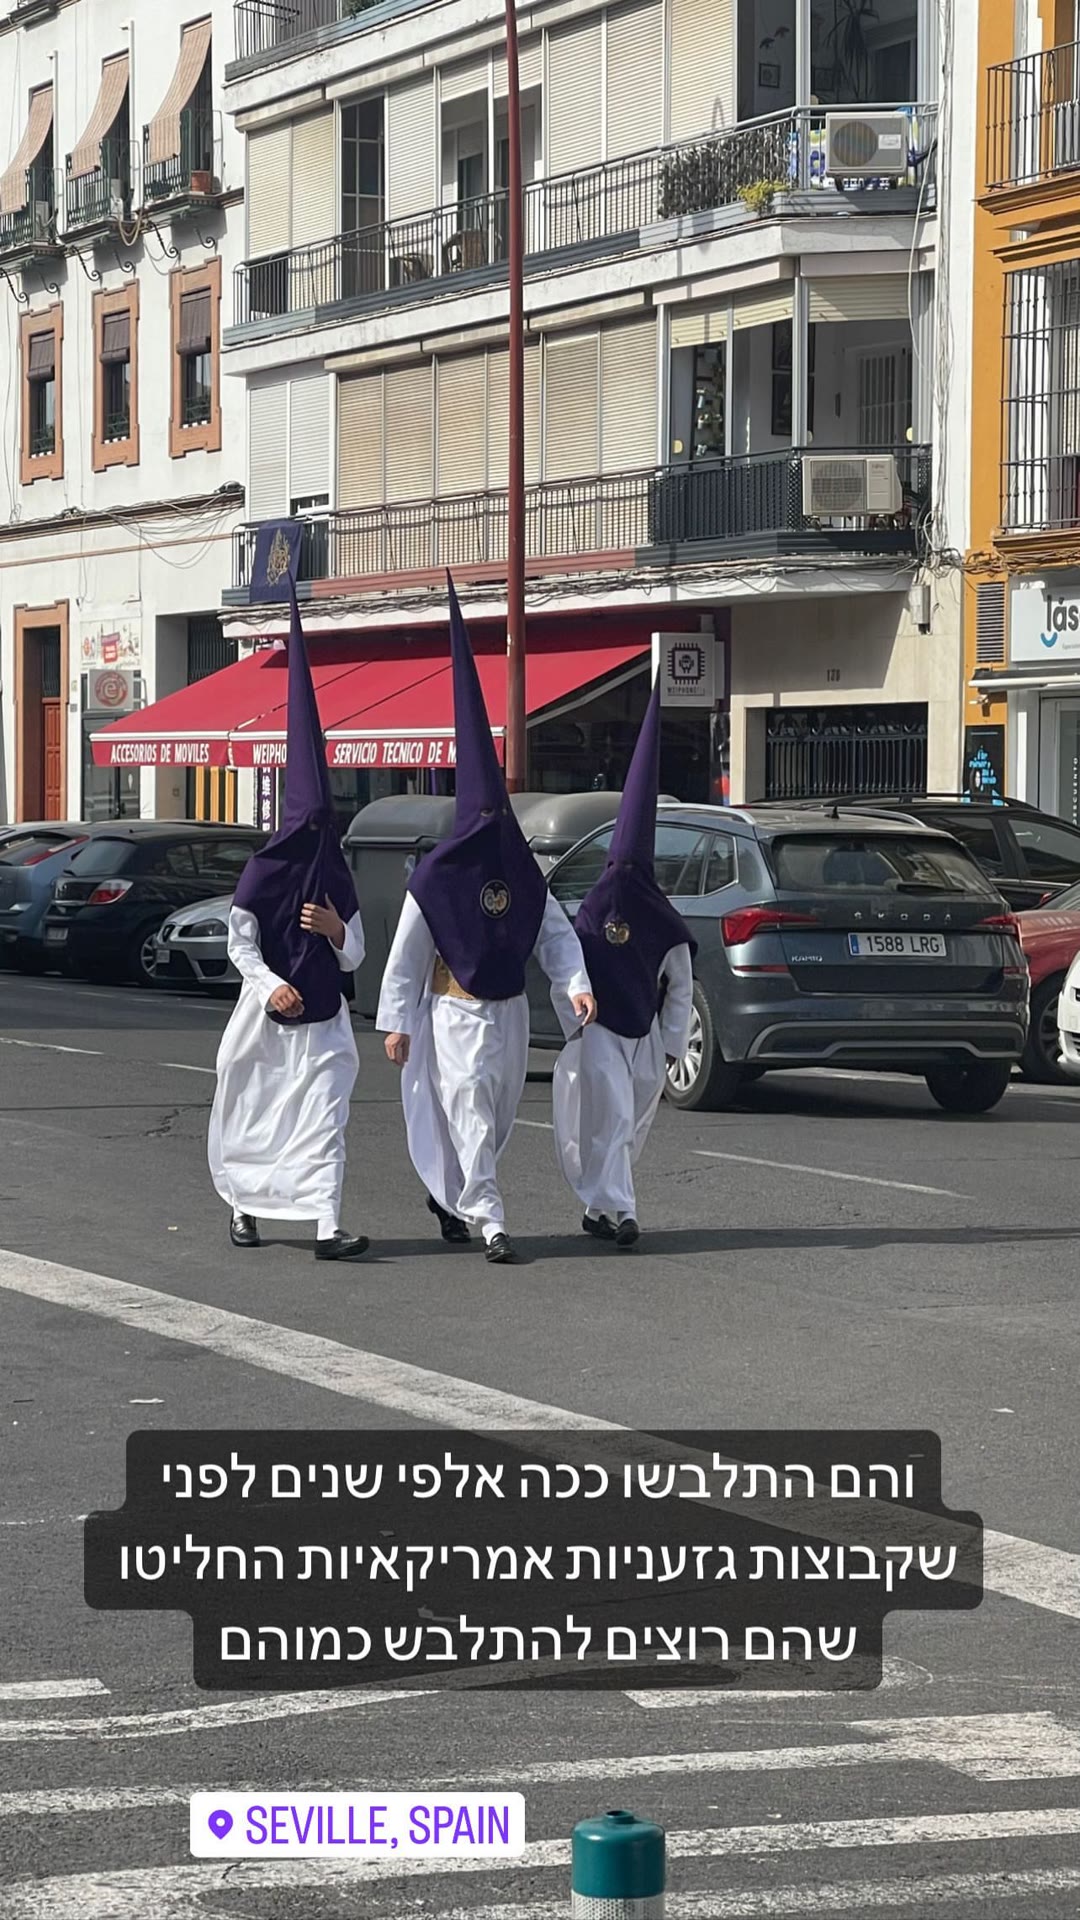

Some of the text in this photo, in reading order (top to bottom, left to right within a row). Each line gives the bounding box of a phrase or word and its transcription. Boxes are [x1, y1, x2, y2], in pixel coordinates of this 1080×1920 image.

[1046, 594, 1080, 633] lás
[110, 743, 210, 764] ACCESORIOS DE MOVILES
[252, 743, 287, 765] WEIPHO
[332, 742, 378, 764] SERVICIO
[382, 742, 424, 764] TECNICO
[427, 741, 443, 763] DE
[867, 936, 940, 954] 1588 LRG
